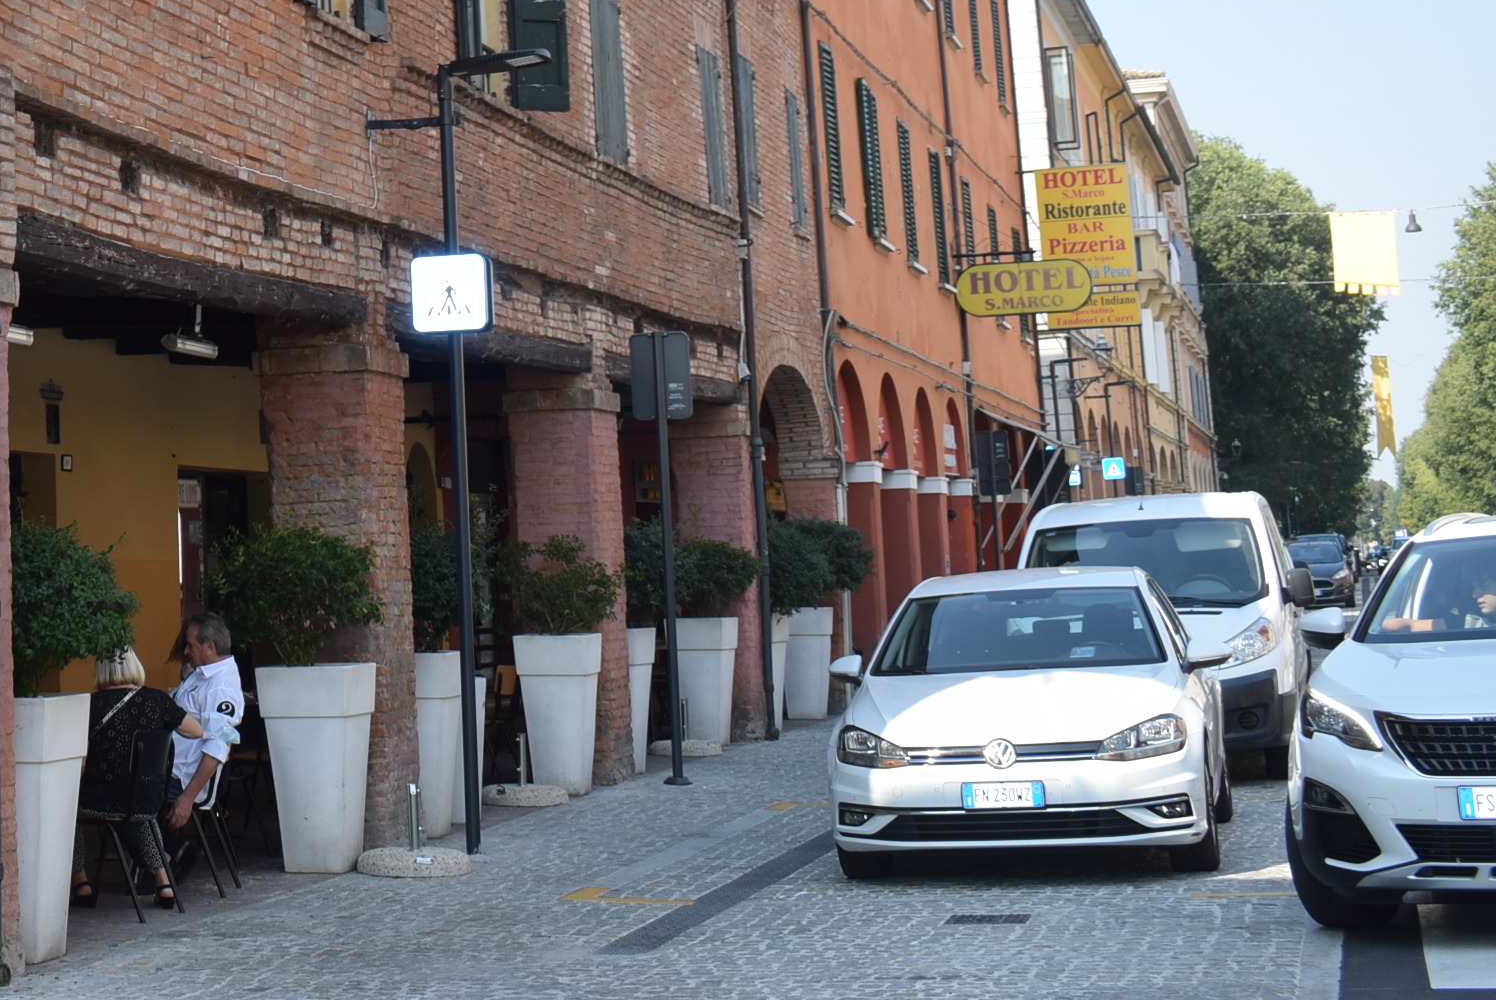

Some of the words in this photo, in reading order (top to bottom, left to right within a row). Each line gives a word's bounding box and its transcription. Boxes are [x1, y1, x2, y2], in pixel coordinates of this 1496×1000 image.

[1042, 168, 1123, 190] HOTEL
[1062, 189, 1105, 200] S.Marco
[1044, 201, 1126, 220] Ristorante
[1067, 222, 1104, 234] BAR
[1048, 235, 1126, 256] Pizzeria
[1102, 265, 1132, 278] Pesce
[969, 266, 1085, 295] HOTEL
[984, 295, 1064, 312] S.MARCO
[1101, 296, 1136, 306] Indiano
[1055, 316, 1097, 326] Tandoori
